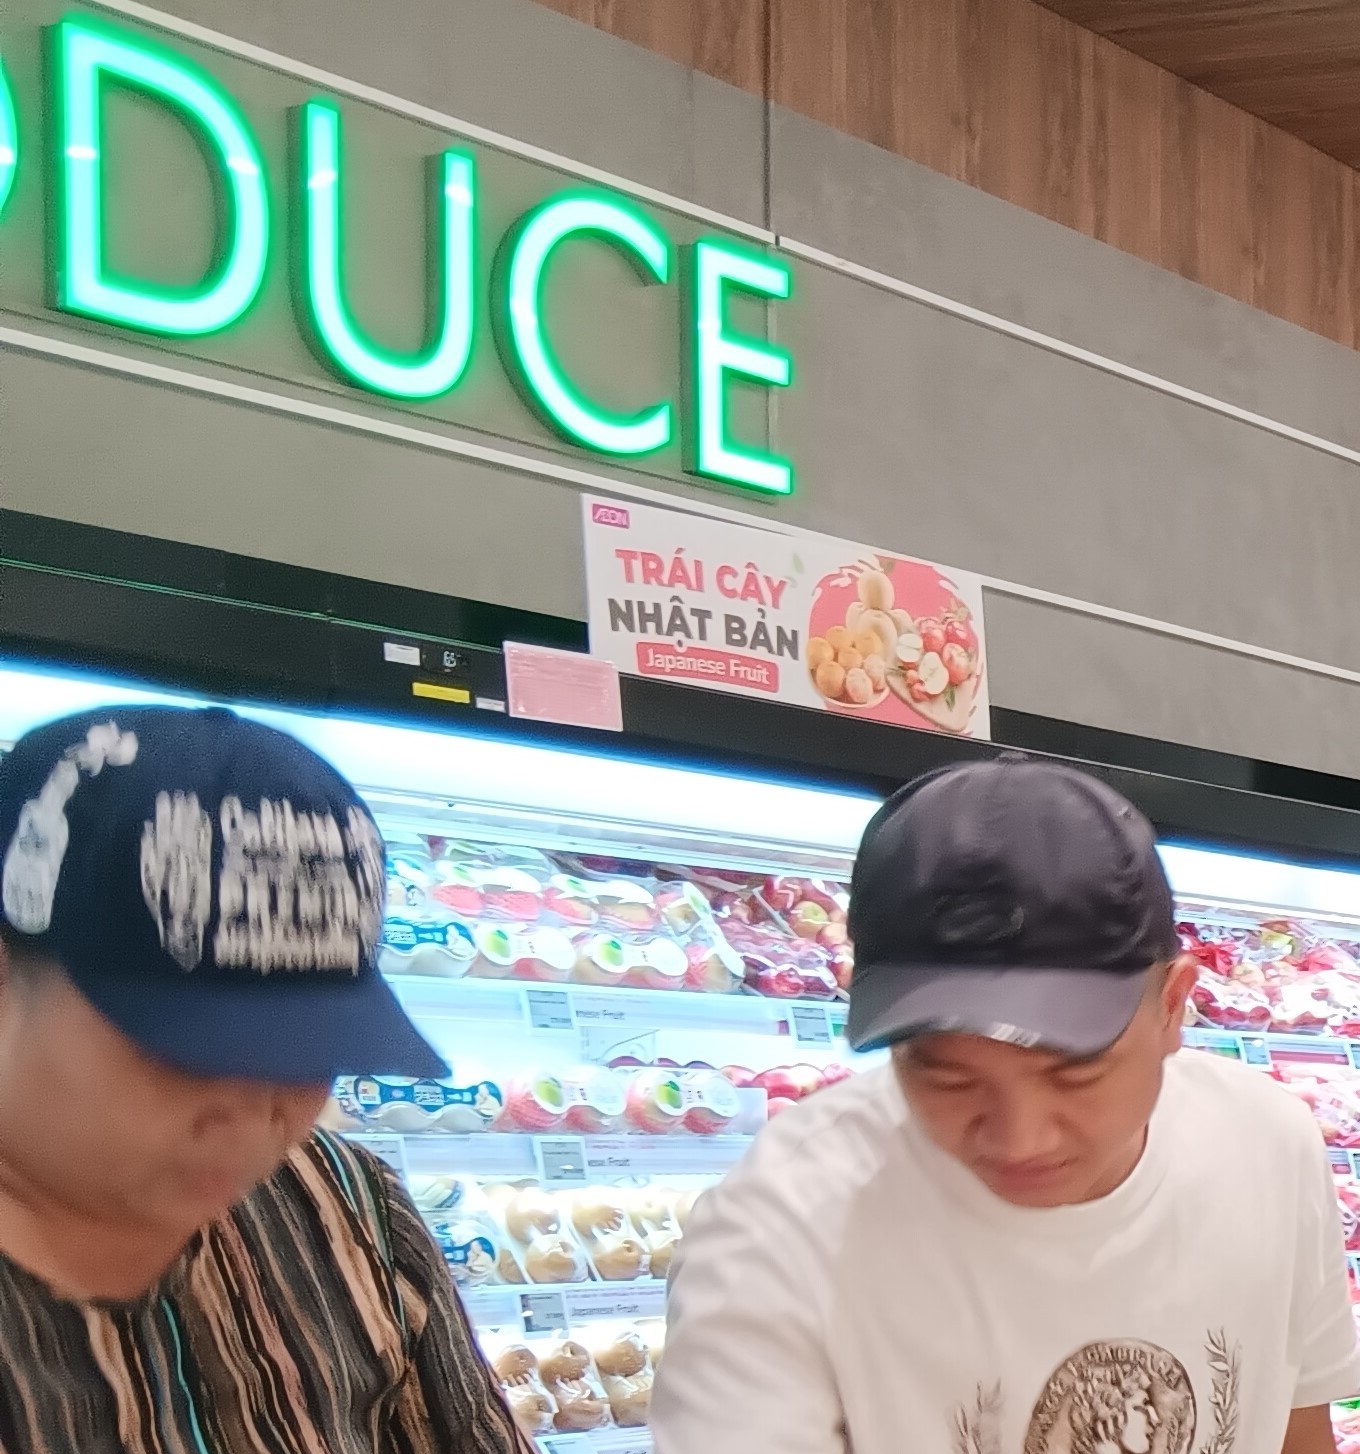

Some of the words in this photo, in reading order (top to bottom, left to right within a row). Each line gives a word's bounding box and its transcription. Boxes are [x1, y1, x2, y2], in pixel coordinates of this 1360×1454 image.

[0, 22, 793, 495] DUCE
[615, 547, 704, 592] TRÁI
[716, 561, 787, 609] CÂY
[607, 595, 712, 648] NHẬT
[724, 607, 799, 660] BẢN
[646, 648, 726, 675] Japanese
[729, 659, 770, 684] Fruit
